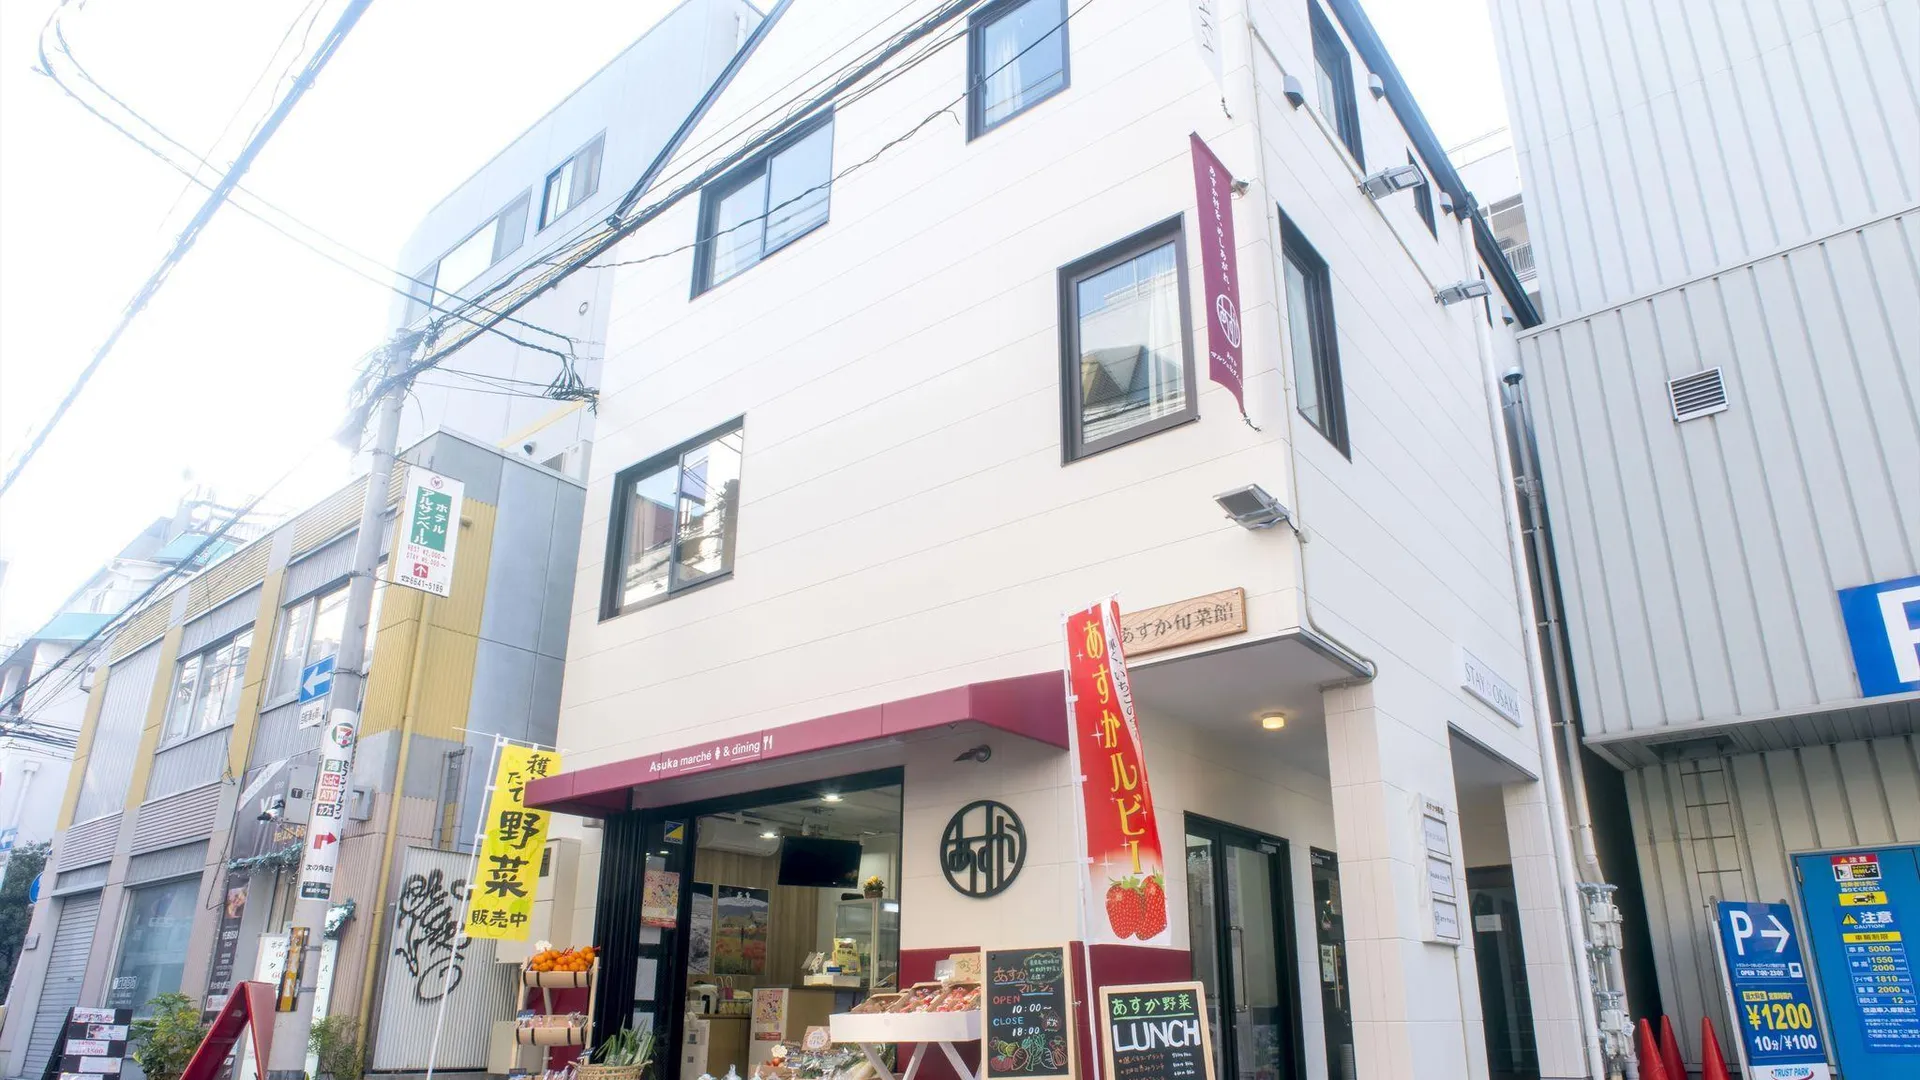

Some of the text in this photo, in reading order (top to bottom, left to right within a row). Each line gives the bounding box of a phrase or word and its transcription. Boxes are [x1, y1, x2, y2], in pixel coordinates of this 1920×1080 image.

[432, 503, 449, 534] ホテル
[1121, 602, 1233, 644] あすか旬菜館
[1492, 684, 1521, 721] OSAKA
[648, 740, 761, 773] Asuka marché & dining
[1084, 620, 1145, 876] あすかルビー
[320, 790, 337, 801] ATM
[507, 772, 522, 802] たて
[484, 810, 541, 898] 野菜
[470, 908, 528, 929] 販売中
[1861, 911, 1894, 924] 注意
[1729, 910, 1754, 956] P
[1868, 945, 1891, 953] 5000
[1871, 957, 1894, 965] 1550
[1872, 964, 1896, 972] 2000
[993, 966, 1029, 983] あすか
[1740, 969, 1756, 977] OPEN
[1875, 975, 1898, 983] 1810
[1016, 982, 1054, 994] マルシェ
[993, 995, 1021, 1005] OPEN
[1111, 993, 1192, 1015] あすか野菜
[992, 1016, 1025, 1027] CLOSE
[1746, 1003, 1813, 1031] ¥1200
[1012, 1026, 1040, 1037] 18:00
[1112, 1019, 1201, 1053] LUNCH
[1754, 1033, 1818, 1051] 10分/¥100
[1774, 1067, 1810, 1078] TRUST PARK
